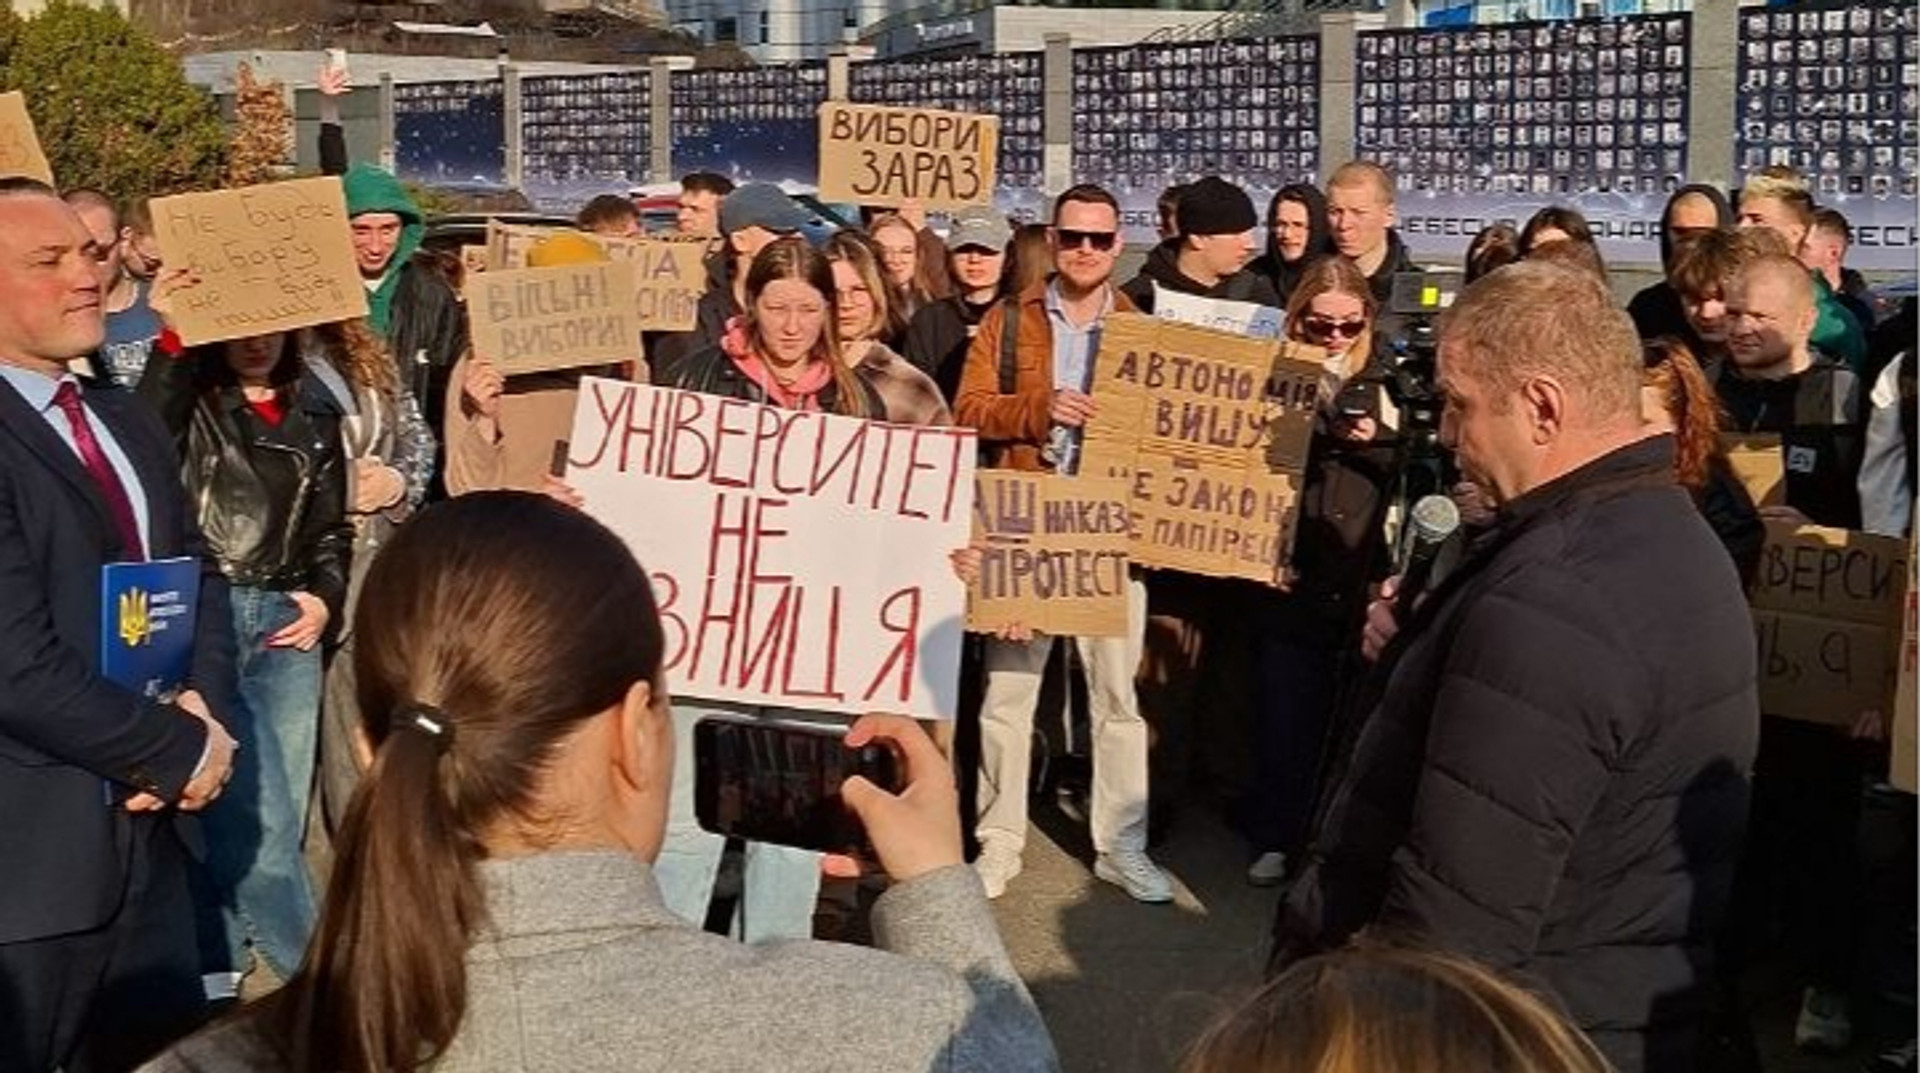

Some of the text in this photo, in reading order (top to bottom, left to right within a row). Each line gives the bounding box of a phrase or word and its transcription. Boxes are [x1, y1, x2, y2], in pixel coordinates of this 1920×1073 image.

[830, 109, 981, 152] ВИБОРИ
[852, 149, 982, 200] ЗАРАЗ
[1154, 399, 1269, 449] ВИШУ
[568, 381, 978, 523] УНІВЕРСИТЕТ
[708, 493, 793, 583] НЕ
[1043, 500, 1128, 534] НАКАЗ
[980, 550, 1128, 600] ПРОТЕСТ
